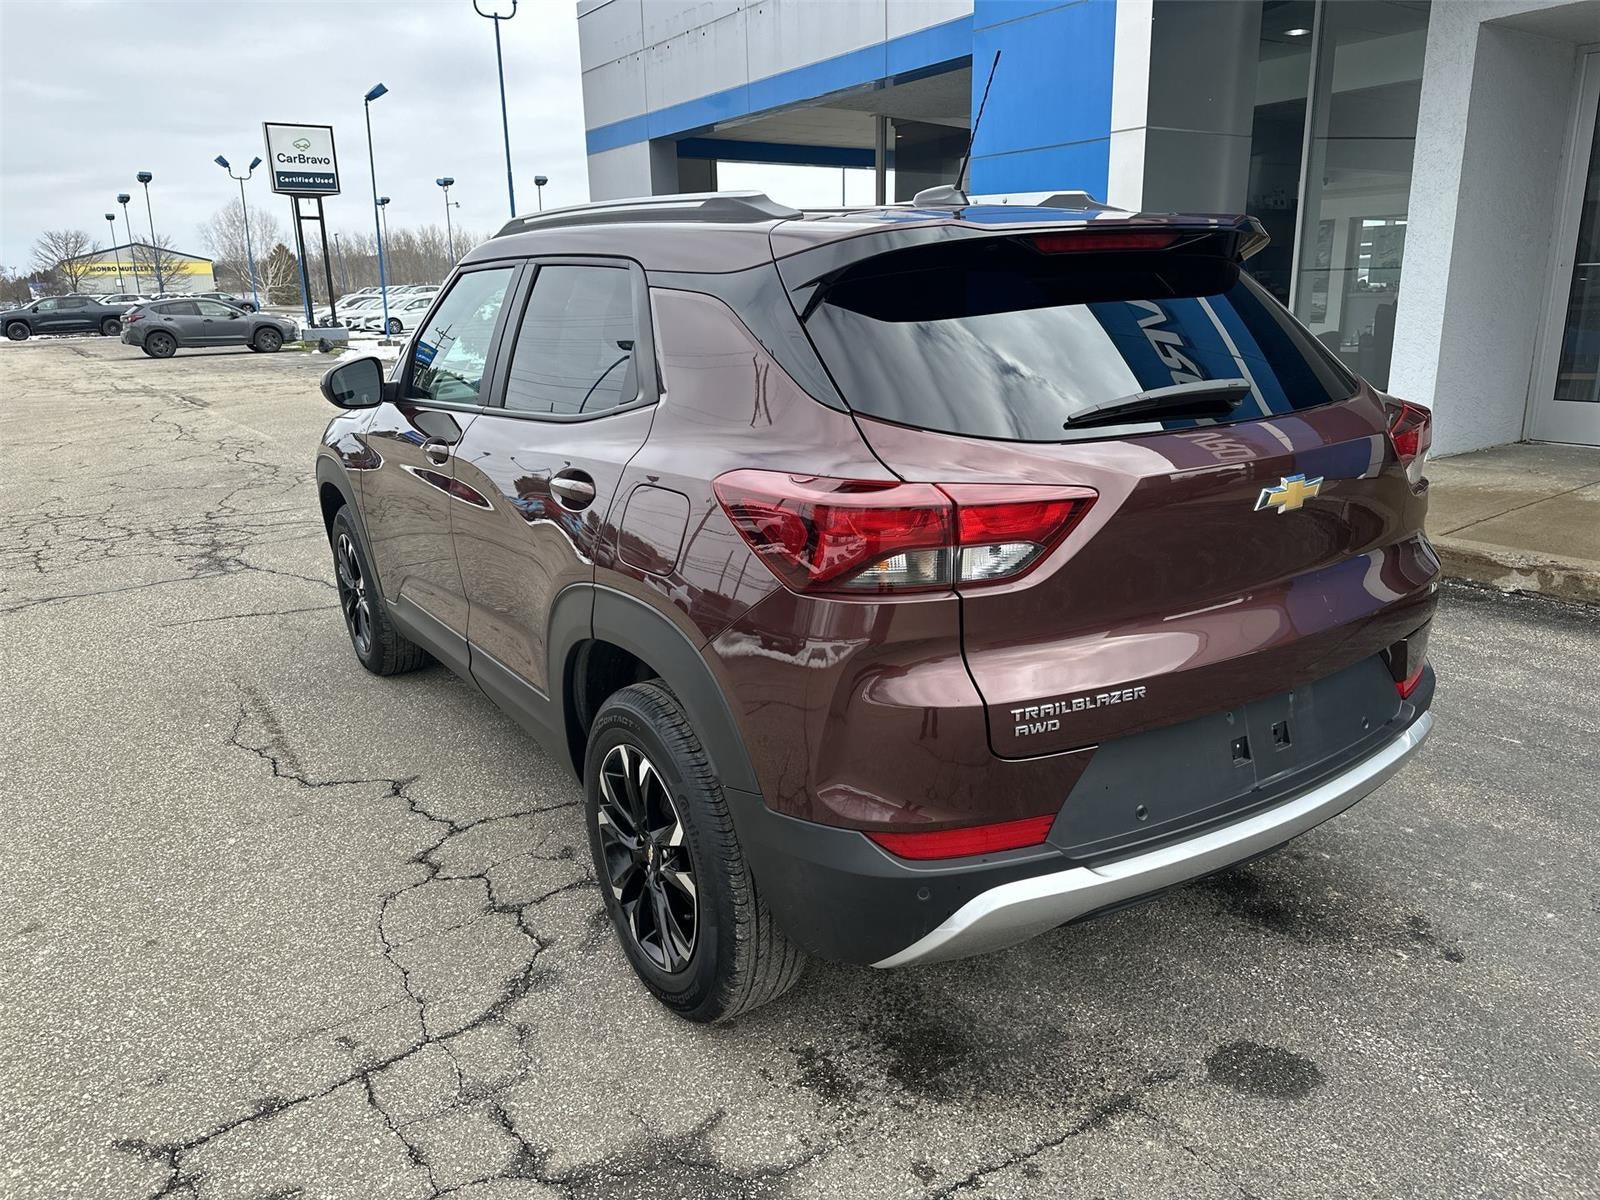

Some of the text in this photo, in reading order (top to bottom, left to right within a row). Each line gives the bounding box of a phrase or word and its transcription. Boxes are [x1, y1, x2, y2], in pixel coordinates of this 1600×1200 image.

[277, 153, 331, 165] CarBravo
[1010, 686, 1147, 722] TRAILBLAZER
[1015, 719, 1060, 737] AWD
